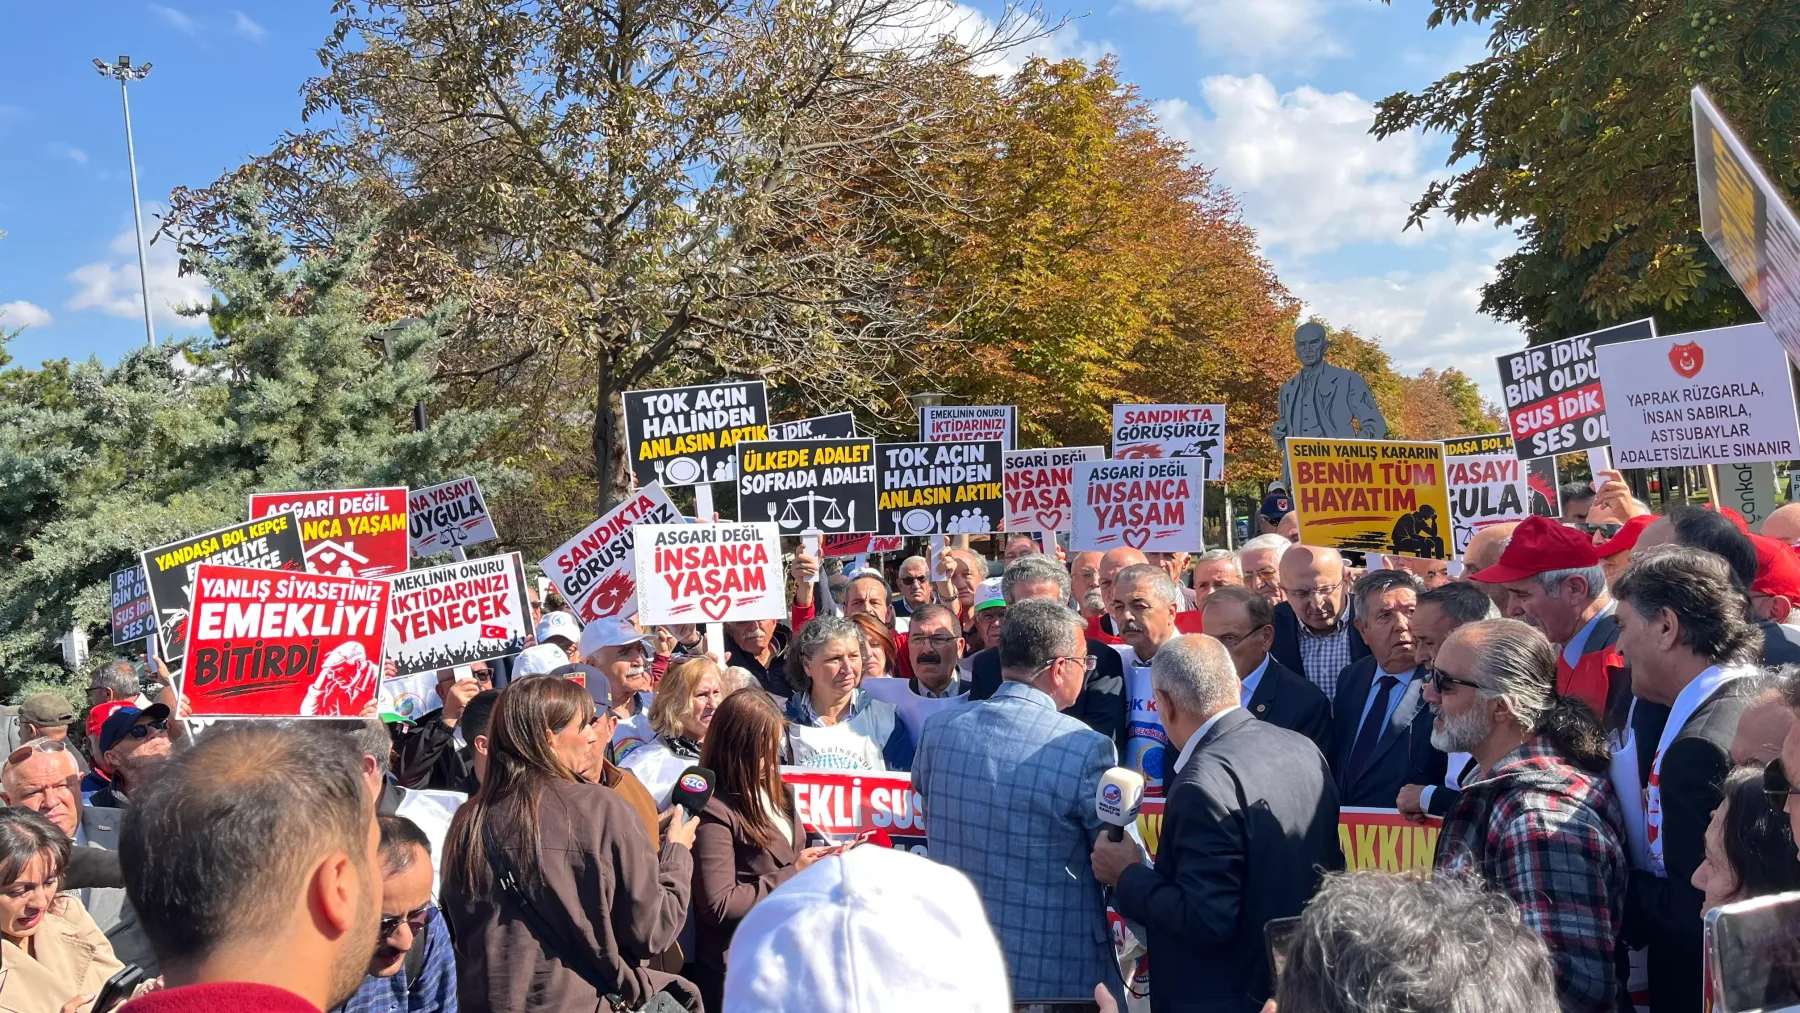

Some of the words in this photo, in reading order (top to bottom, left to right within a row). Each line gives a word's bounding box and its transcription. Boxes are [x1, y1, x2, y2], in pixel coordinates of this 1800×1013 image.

[1510, 350, 1547, 380] BİR
[1551, 337, 1593, 367] İDİK
[1506, 376, 1544, 407] BİN
[1549, 359, 1600, 391] OLDU
[1626, 389, 1681, 407] YAPRAK
[1684, 382, 1764, 401] RÜZGARLA,
[643, 392, 690, 417] TOK
[695, 386, 747, 412] AÇIN
[930, 408, 975, 420] EMEKLİNİN
[976, 408, 1006, 418] ONURU
[1515, 405, 1555, 434] SUS
[1558, 390, 1601, 420] İDİK
[1643, 408, 1683, 424] İNSAN
[1687, 403, 1752, 420] SABIRLA,
[643, 406, 756, 439] HALİNDEN
[782, 420, 813, 440] İDİK
[931, 418, 1006, 433] İKTİDARINIZI
[1124, 408, 1213, 425] SANDIKTA
[639, 431, 716, 461] ANLASIN
[719, 424, 769, 449] ARTIK
[1116, 421, 1221, 442] GÖRÜŞÜRÜZ
[1532, 424, 1577, 456] SES
[1583, 414, 1610, 442] OL
[1651, 423, 1750, 443] ASTSUBAYLAR
[743, 448, 809, 473] ÜLKEDE
[813, 444, 871, 466] ADALET
[886, 447, 929, 468] TOK
[934, 444, 985, 466] AÇIN
[1004, 451, 1048, 469] SGARİ
[1293, 441, 1331, 458] SENİN
[1333, 445, 1378, 461] YANLIŞ
[1381, 445, 1439, 460] KARARIN
[1446, 440, 1478, 455] DAŞA
[1481, 437, 1504, 451] BOL
[1620, 441, 1730, 463] ADALETSİZLİKLE
[1733, 440, 1792, 457] SINANIR
[741, 469, 818, 496] SOFRADA
[821, 465, 875, 487] ADALET
[884, 462, 992, 490] HALİNDEN
[1004, 467, 1072, 491] NSAN
[1088, 461, 1144, 481] ASGARİ
[1148, 460, 1188, 478] DEĞİL
[1297, 458, 1373, 485] BENİM
[1379, 460, 1437, 486] TÜM
[1447, 459, 1518, 486] YASAYI
[266, 496, 335, 519] ASGARİ
[339, 492, 390, 515] DEĞİL
[409, 494, 431, 515] NA
[428, 480, 475, 505] YASAYI
[878, 485, 951, 510] ANLASIN
[955, 482, 1002, 501] ARTIK
[1005, 487, 1071, 515] YAŞA
[1086, 479, 1190, 506] İNSANCA
[1300, 487, 1417, 513] HAYATIM
[1449, 484, 1523, 518] ULA
[301, 518, 343, 541] NCA
[347, 512, 406, 537] YAŞAM
[409, 495, 485, 539] UYGULA
[1093, 501, 1185, 532] YAŞAM
[155, 537, 220, 572] YANDAŞA
[221, 528, 248, 548] BOL
[249, 516, 288, 539] KEPÇE
[557, 494, 656, 574] SANDIKTA
[655, 526, 717, 547] ASGARİ
[722, 525, 764, 542] DEĞİL
[563, 503, 675, 596] GÖRÜŞÜÜZ
[654, 543, 769, 574] İNSANCA
[116, 569, 134, 590] BİR
[201, 578, 272, 602] YANLIŞ
[275, 576, 383, 601] SİYASETİNİZ
[392, 567, 457, 593] MEKLİNİN
[460, 560, 505, 579] ONURU
[663, 566, 767, 602] YAŞAM
[112, 587, 131, 608] BİN
[391, 574, 510, 616] İKTİDARINIZI
[115, 606, 135, 626] SUS
[136, 597, 152, 617] İDİ
[198, 600, 378, 640] EMEKLİYİ
[390, 593, 511, 644] YENECEK
[122, 619, 143, 641] SES
[194, 638, 320, 687] BİTİRDİ
[684, 777, 705, 790] SZC
[794, 778, 862, 827] EKLİ
[870, 787, 926, 831] SUS
[1338, 824, 1442, 876] AKKIN
